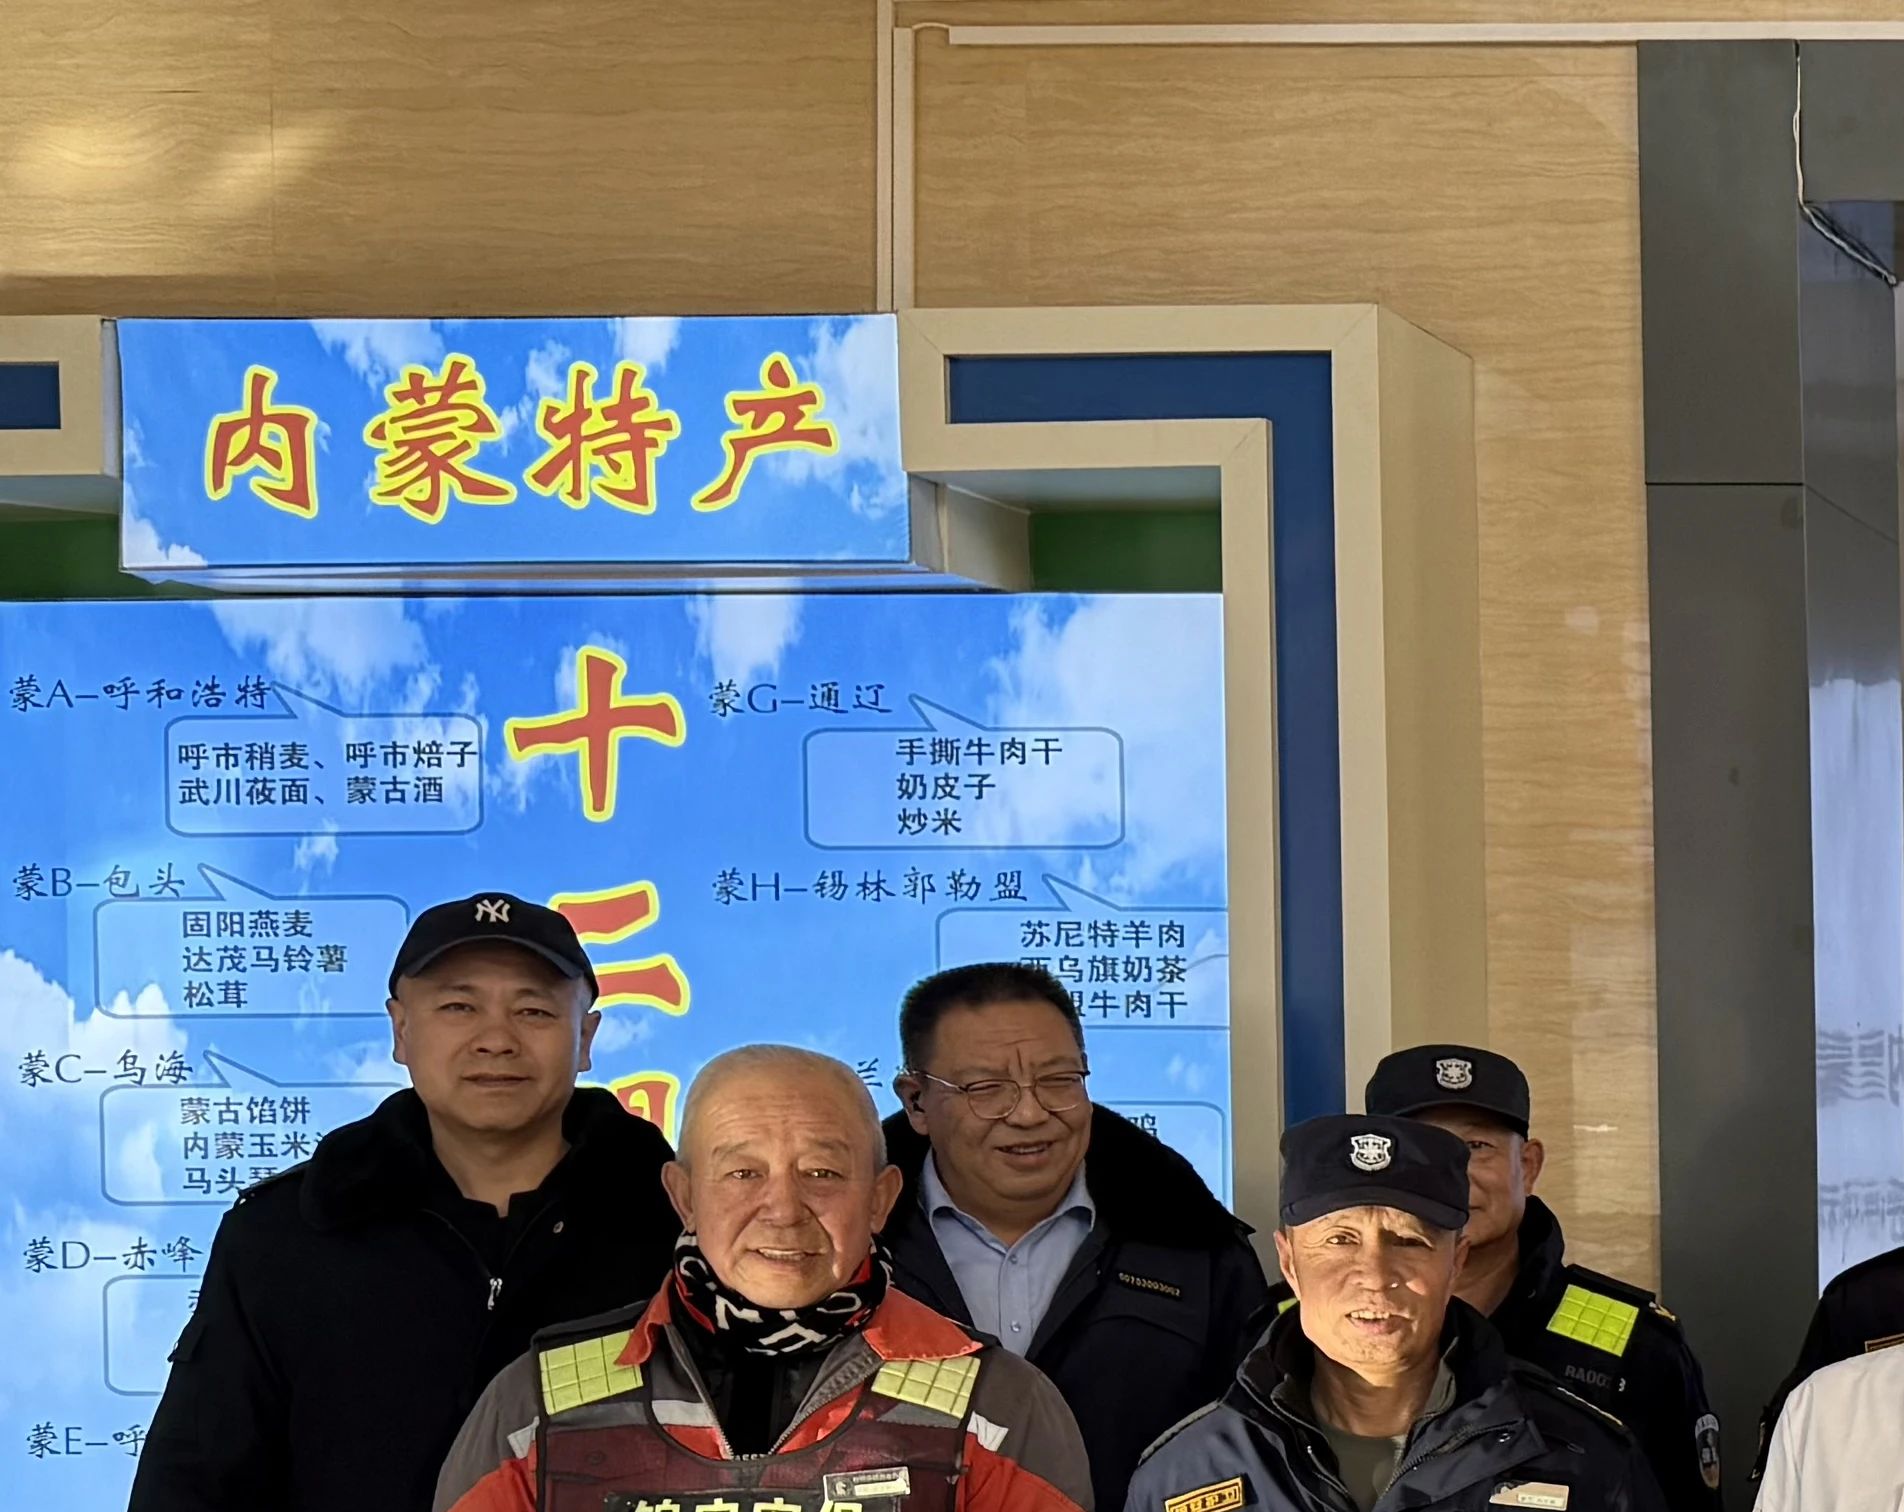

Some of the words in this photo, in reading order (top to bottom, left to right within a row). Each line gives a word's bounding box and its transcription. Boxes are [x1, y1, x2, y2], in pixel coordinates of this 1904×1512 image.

[203, 352, 839, 524] 内蒙特产
[178, 741, 478, 770] 呼市稍麦、呼市焙子
[896, 736, 1063, 766] 手撕牛肉干
[178, 776, 444, 805] 武川莜面、蒙古酒
[897, 772, 996, 801] 奶皮子
[897, 808, 962, 835] 炒米
[182, 910, 313, 939] 固阳燕麦
[1020, 920, 1186, 948] 苏尼特羊肉
[182, 945, 348, 973] 达茂马铃薯
[182, 980, 248, 1009] 松茸
[180, 1096, 311, 1126] 蒙古馅饼
[183, 1132, 324, 1161] 内蒙玉米
